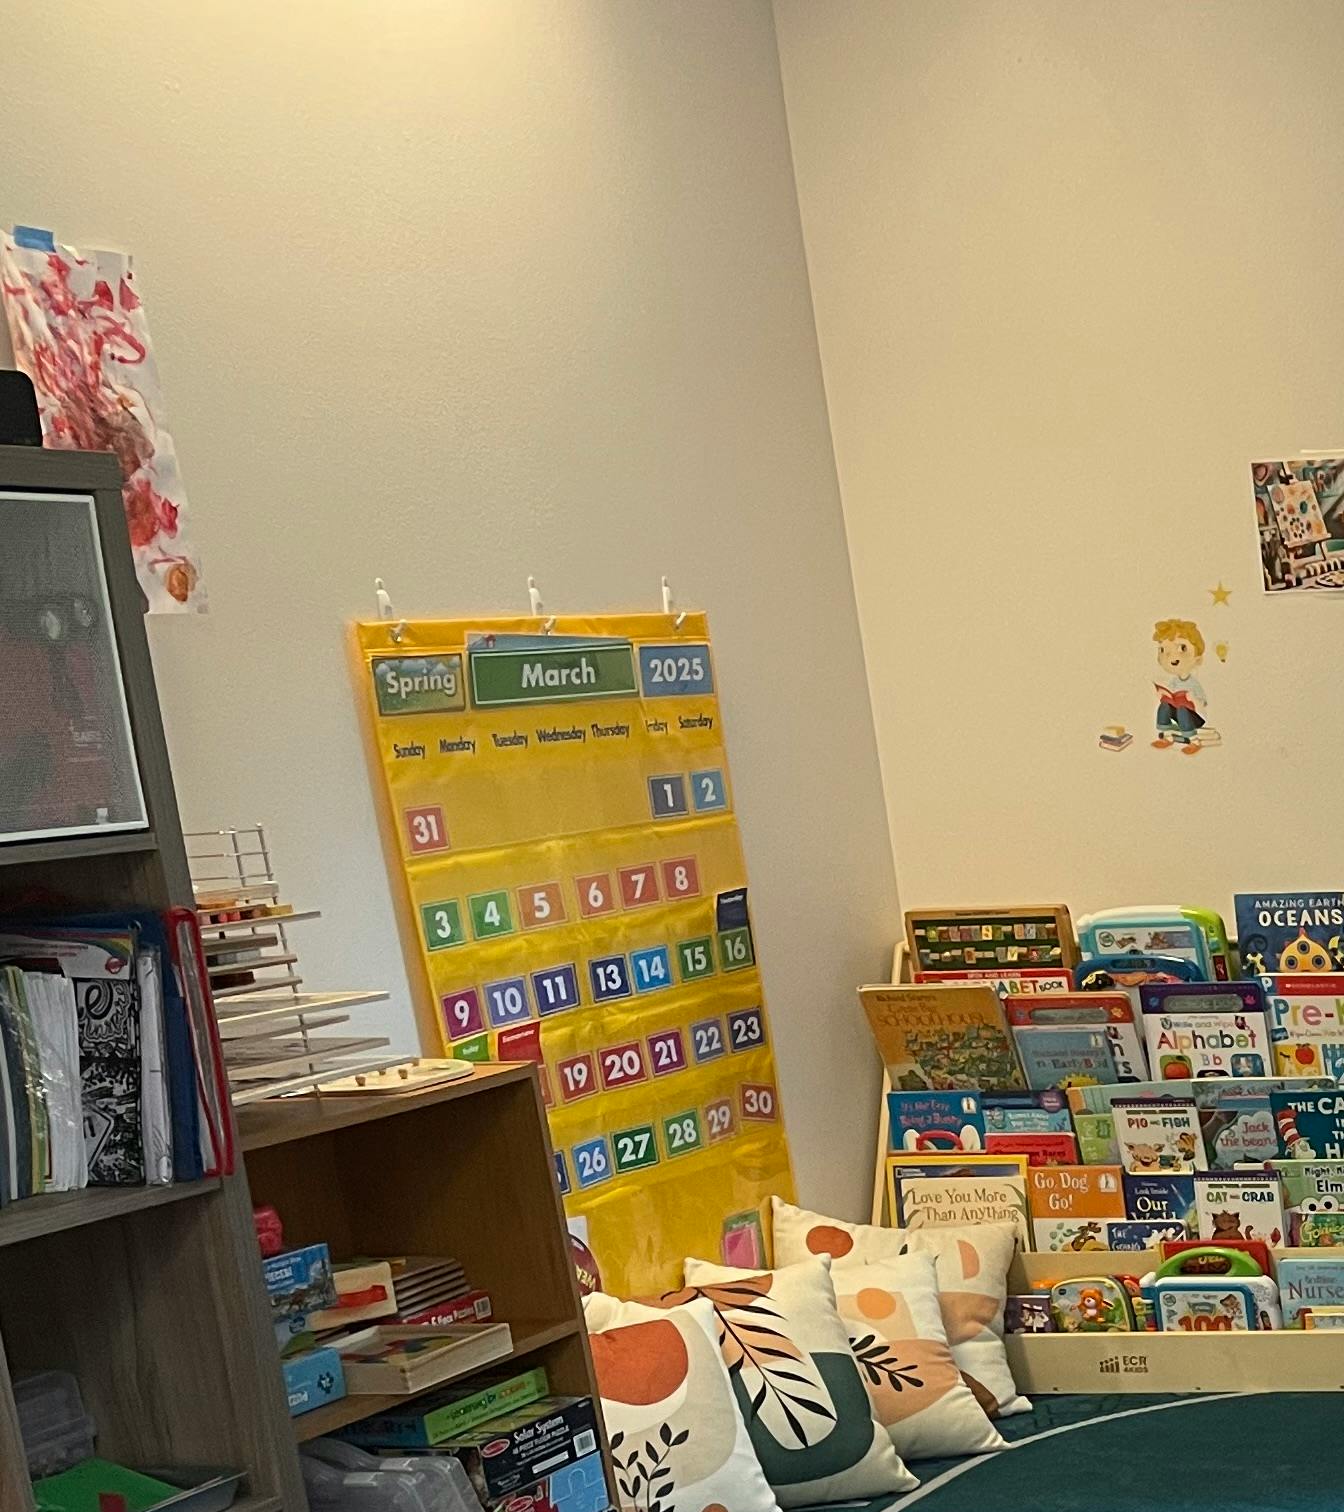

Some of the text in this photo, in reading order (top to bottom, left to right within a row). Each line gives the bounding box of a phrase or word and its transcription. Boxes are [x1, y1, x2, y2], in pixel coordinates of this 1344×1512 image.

[386, 657, 704, 699] Spring March 2025
[393, 743, 426, 760] Sunday
[439, 738, 475, 755] Monday
[492, 733, 528, 749] Tuesday
[536, 727, 586, 744] Wednesday
[591, 722, 630, 739] Thursday
[678, 713, 713, 730] Saturday
[663, 777, 717, 808] 1 2
[413, 814, 439, 844] 31
[435, 865, 688, 938] 3 4 5 6 7 8
[1254, 899, 1305, 910] AMAZING
[1258, 908, 1344, 927] OCEANS
[455, 937, 746, 1027] 9 10 11 13 14 15 16
[1157, 1028, 1257, 1055] Alphabet
[564, 1016, 761, 1091] 19 20 21 22 23
[1288, 1101, 1315, 1113] THE
[579, 1148, 606, 1177] 26
[618, 1132, 651, 1163] 27
[669, 1118, 697, 1148] 28
[708, 1105, 731, 1133] 29
[745, 1089, 772, 1115] 30
[1241, 1120, 1269, 1134] Jack
[911, 1187, 1007, 1205] Love You More
[1049, 1194, 1073, 1212] Go!
[1136, 1196, 1168, 1212] Our
[1207, 1191, 1228, 1204] CAT
[1241, 1191, 1275, 1203] CRAB
[923, 1204, 1019, 1223] Than Anything
[1122, 1355, 1147, 1366] ECR
[513, 1415, 564, 1444] Solar System
